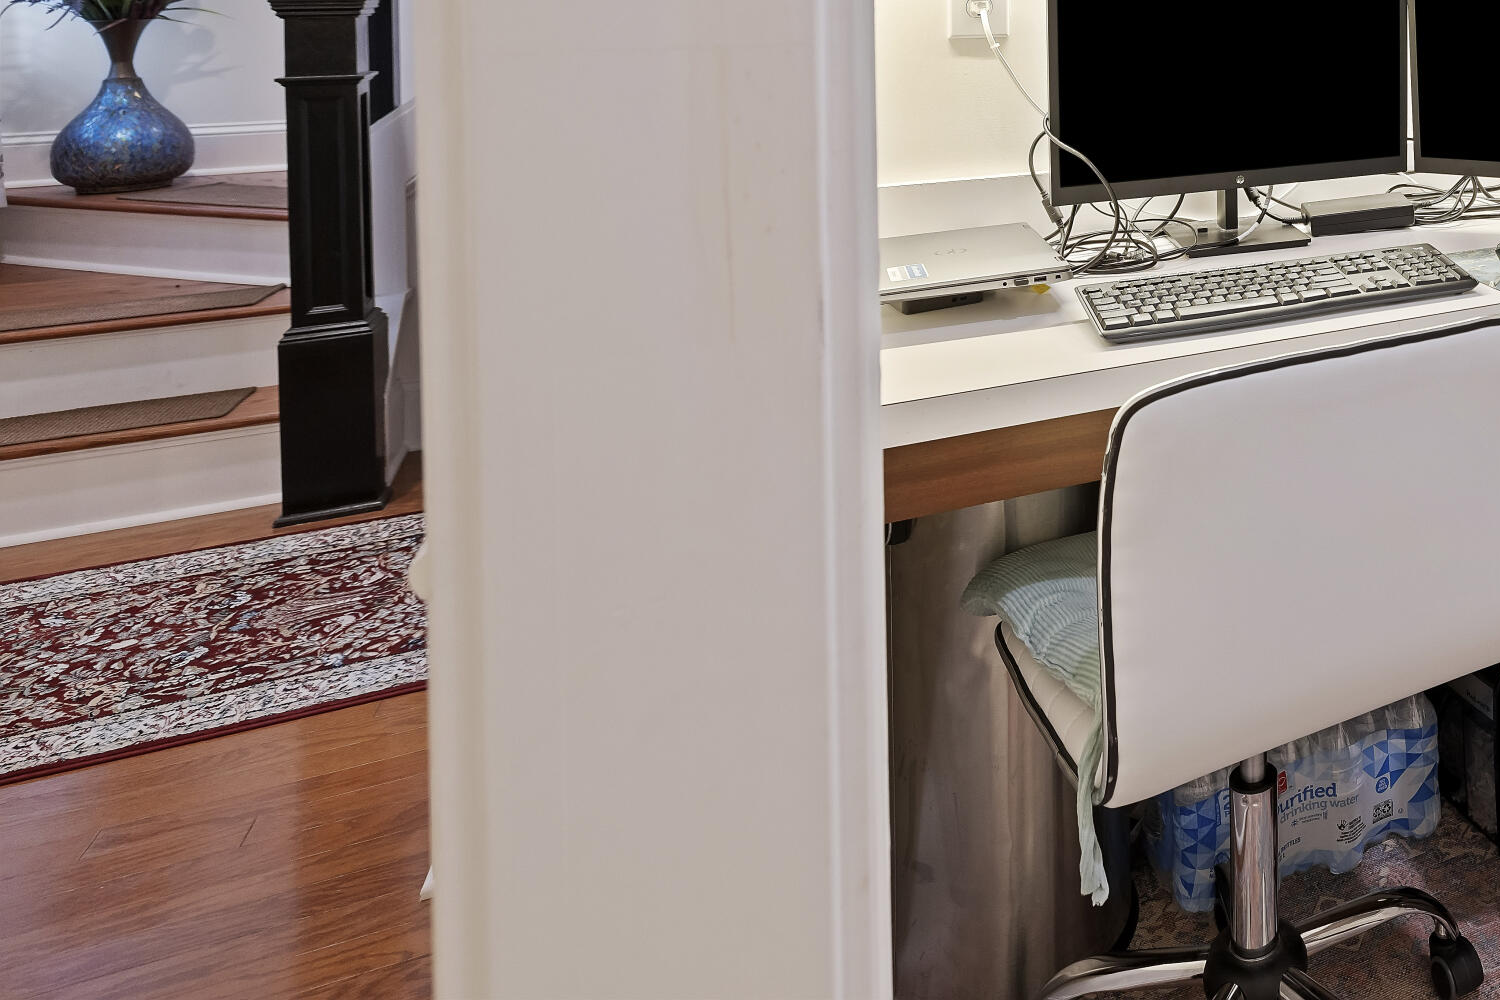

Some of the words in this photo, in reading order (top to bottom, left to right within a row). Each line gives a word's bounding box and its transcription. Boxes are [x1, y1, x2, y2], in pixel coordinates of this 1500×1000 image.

[1277, 782, 1338, 816] urified
[1280, 798, 1328, 824] drinking
[1329, 794, 1359, 808] water
